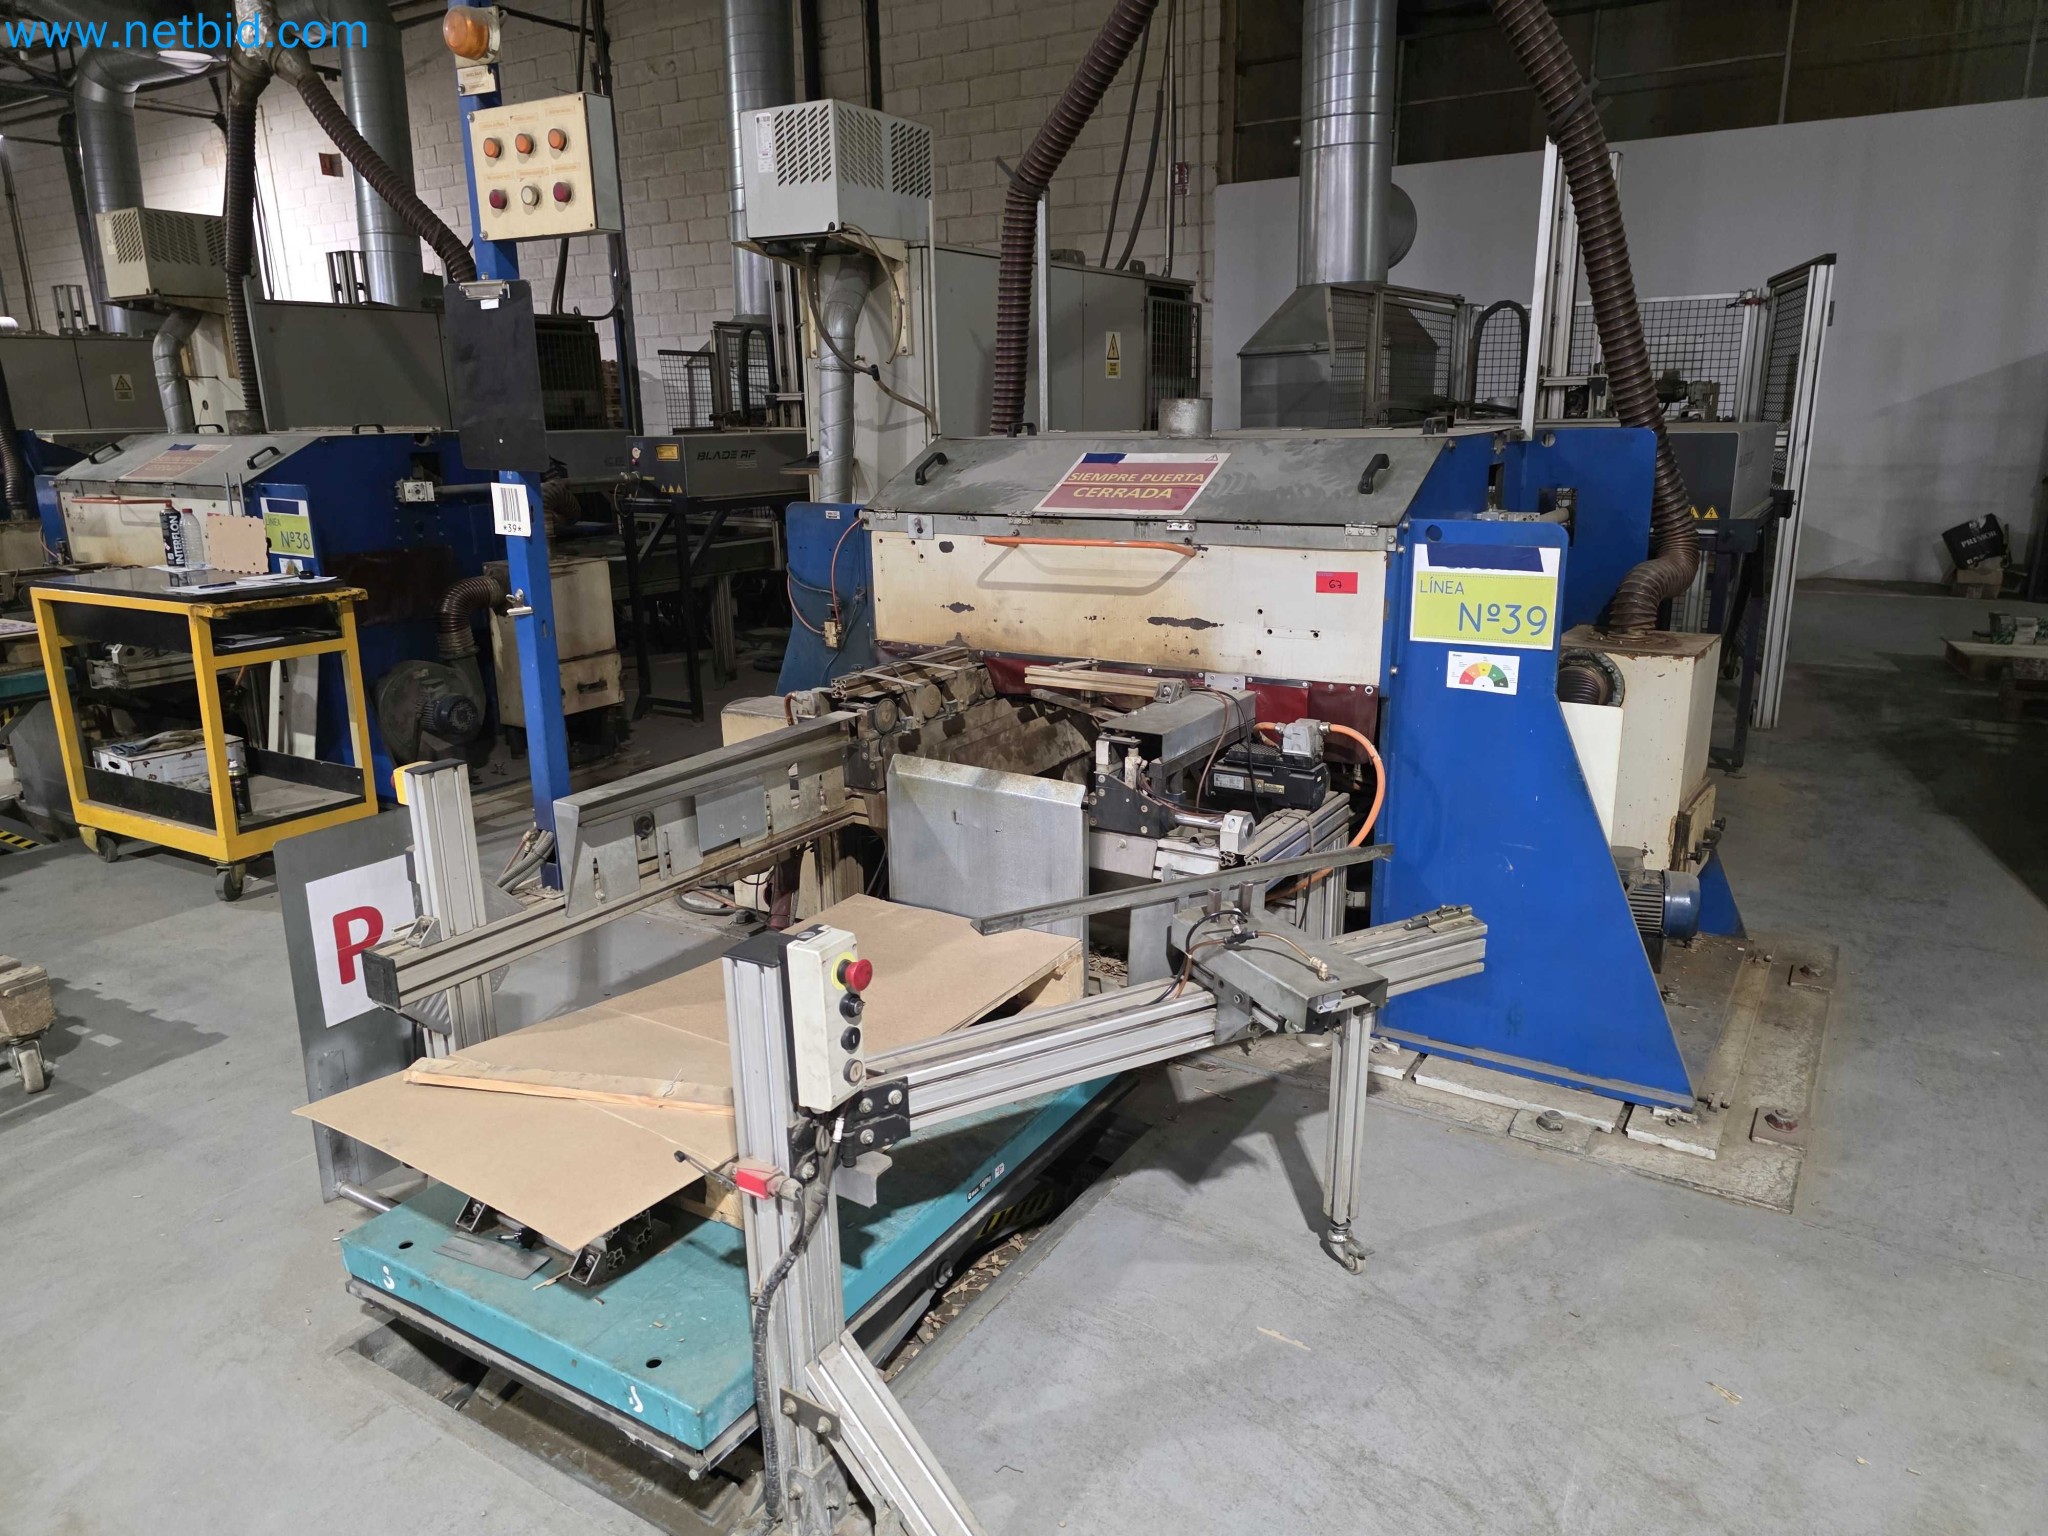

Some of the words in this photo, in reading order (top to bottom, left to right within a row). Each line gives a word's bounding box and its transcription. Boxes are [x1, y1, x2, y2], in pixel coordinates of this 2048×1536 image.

[697, 450, 738, 461] BLADE
[1068, 472, 1139, 482] SIEMPRE
[1139, 473, 1205, 483] PUERTA
[1073, 487, 1174, 499] CERRADA
[169, 515, 185, 565] INTERFLON
[280, 531, 311, 550] Nº38
[1419, 576, 1465, 595] LÍNEA
[1458, 602, 1548, 636] Nº39
[332, 905, 384, 985] P
